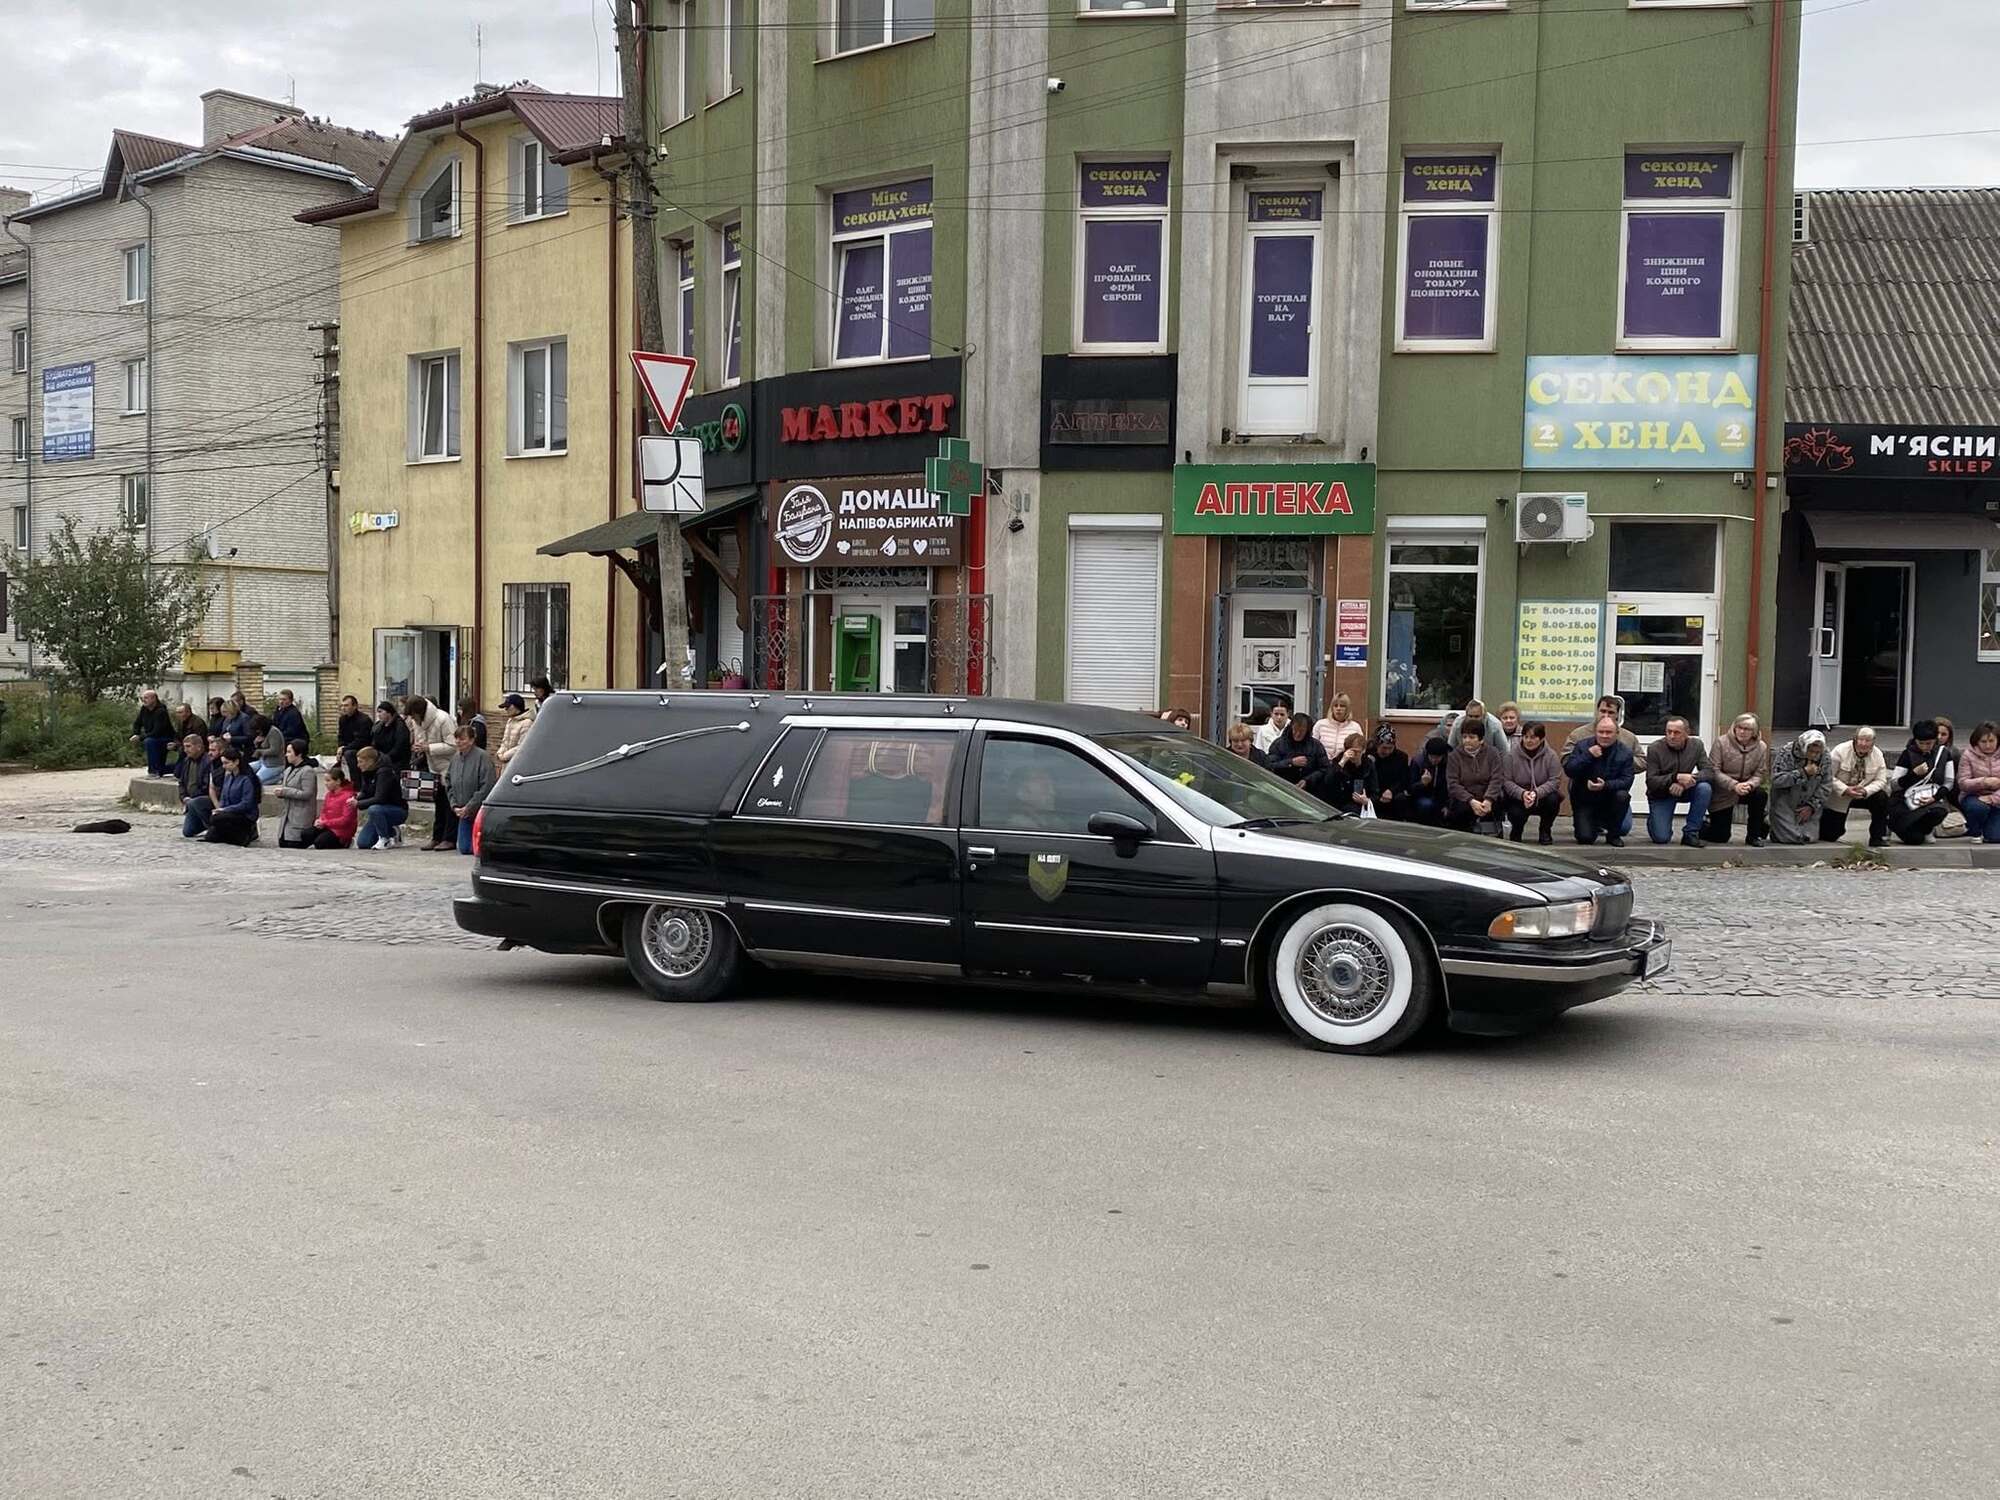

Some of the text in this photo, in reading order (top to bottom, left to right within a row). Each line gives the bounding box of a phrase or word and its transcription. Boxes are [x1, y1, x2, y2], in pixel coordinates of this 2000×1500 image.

[871, 190, 908, 207] Мікс
[1109, 264, 1137, 273] ОДЯГ
[1429, 260, 1464, 268] ПОВНЕ
[1093, 274, 1152, 283] ПРОВІДНИХ
[1414, 270, 1478, 278] ОНОВЛЕННЯ
[1424, 280, 1467, 288] ТОВАРУ
[1646, 277, 1701, 286] КОЖНОГО
[1109, 284, 1135, 292] ФІРМ
[1661, 287, 1685, 296] ДНЯ
[1102, 293, 1142, 302] ЄВРОПИ
[1410, 289, 1480, 298] ЩОВІВТОРКА
[1274, 304, 1289, 312] НА
[1268, 314, 1295, 322] ВАГУ
[1529, 371, 1752, 409] СЕКОНД
[1050, 412, 1164, 431] АПТЕКА
[1539, 424, 1556, 441] 2
[1573, 421, 1705, 453] ХЕНД
[1726, 424, 1742, 441] 2
[1870, 434, 2000, 457] М'ЯСНИ
[1927, 460, 1993, 473] SKLEP
[1194, 483, 1354, 516] АПТЕКА
[839, 516, 954, 530] НАПІВФАБРИКАТИ
[1522, 606, 1538, 615] Вт
[1522, 620, 1537, 630] Ср
[1521, 634, 1537, 643] Чт
[1521, 648, 1537, 657] Пт
[1520, 661, 1536, 671] Сб
[1519, 690, 1535, 699] Пн
